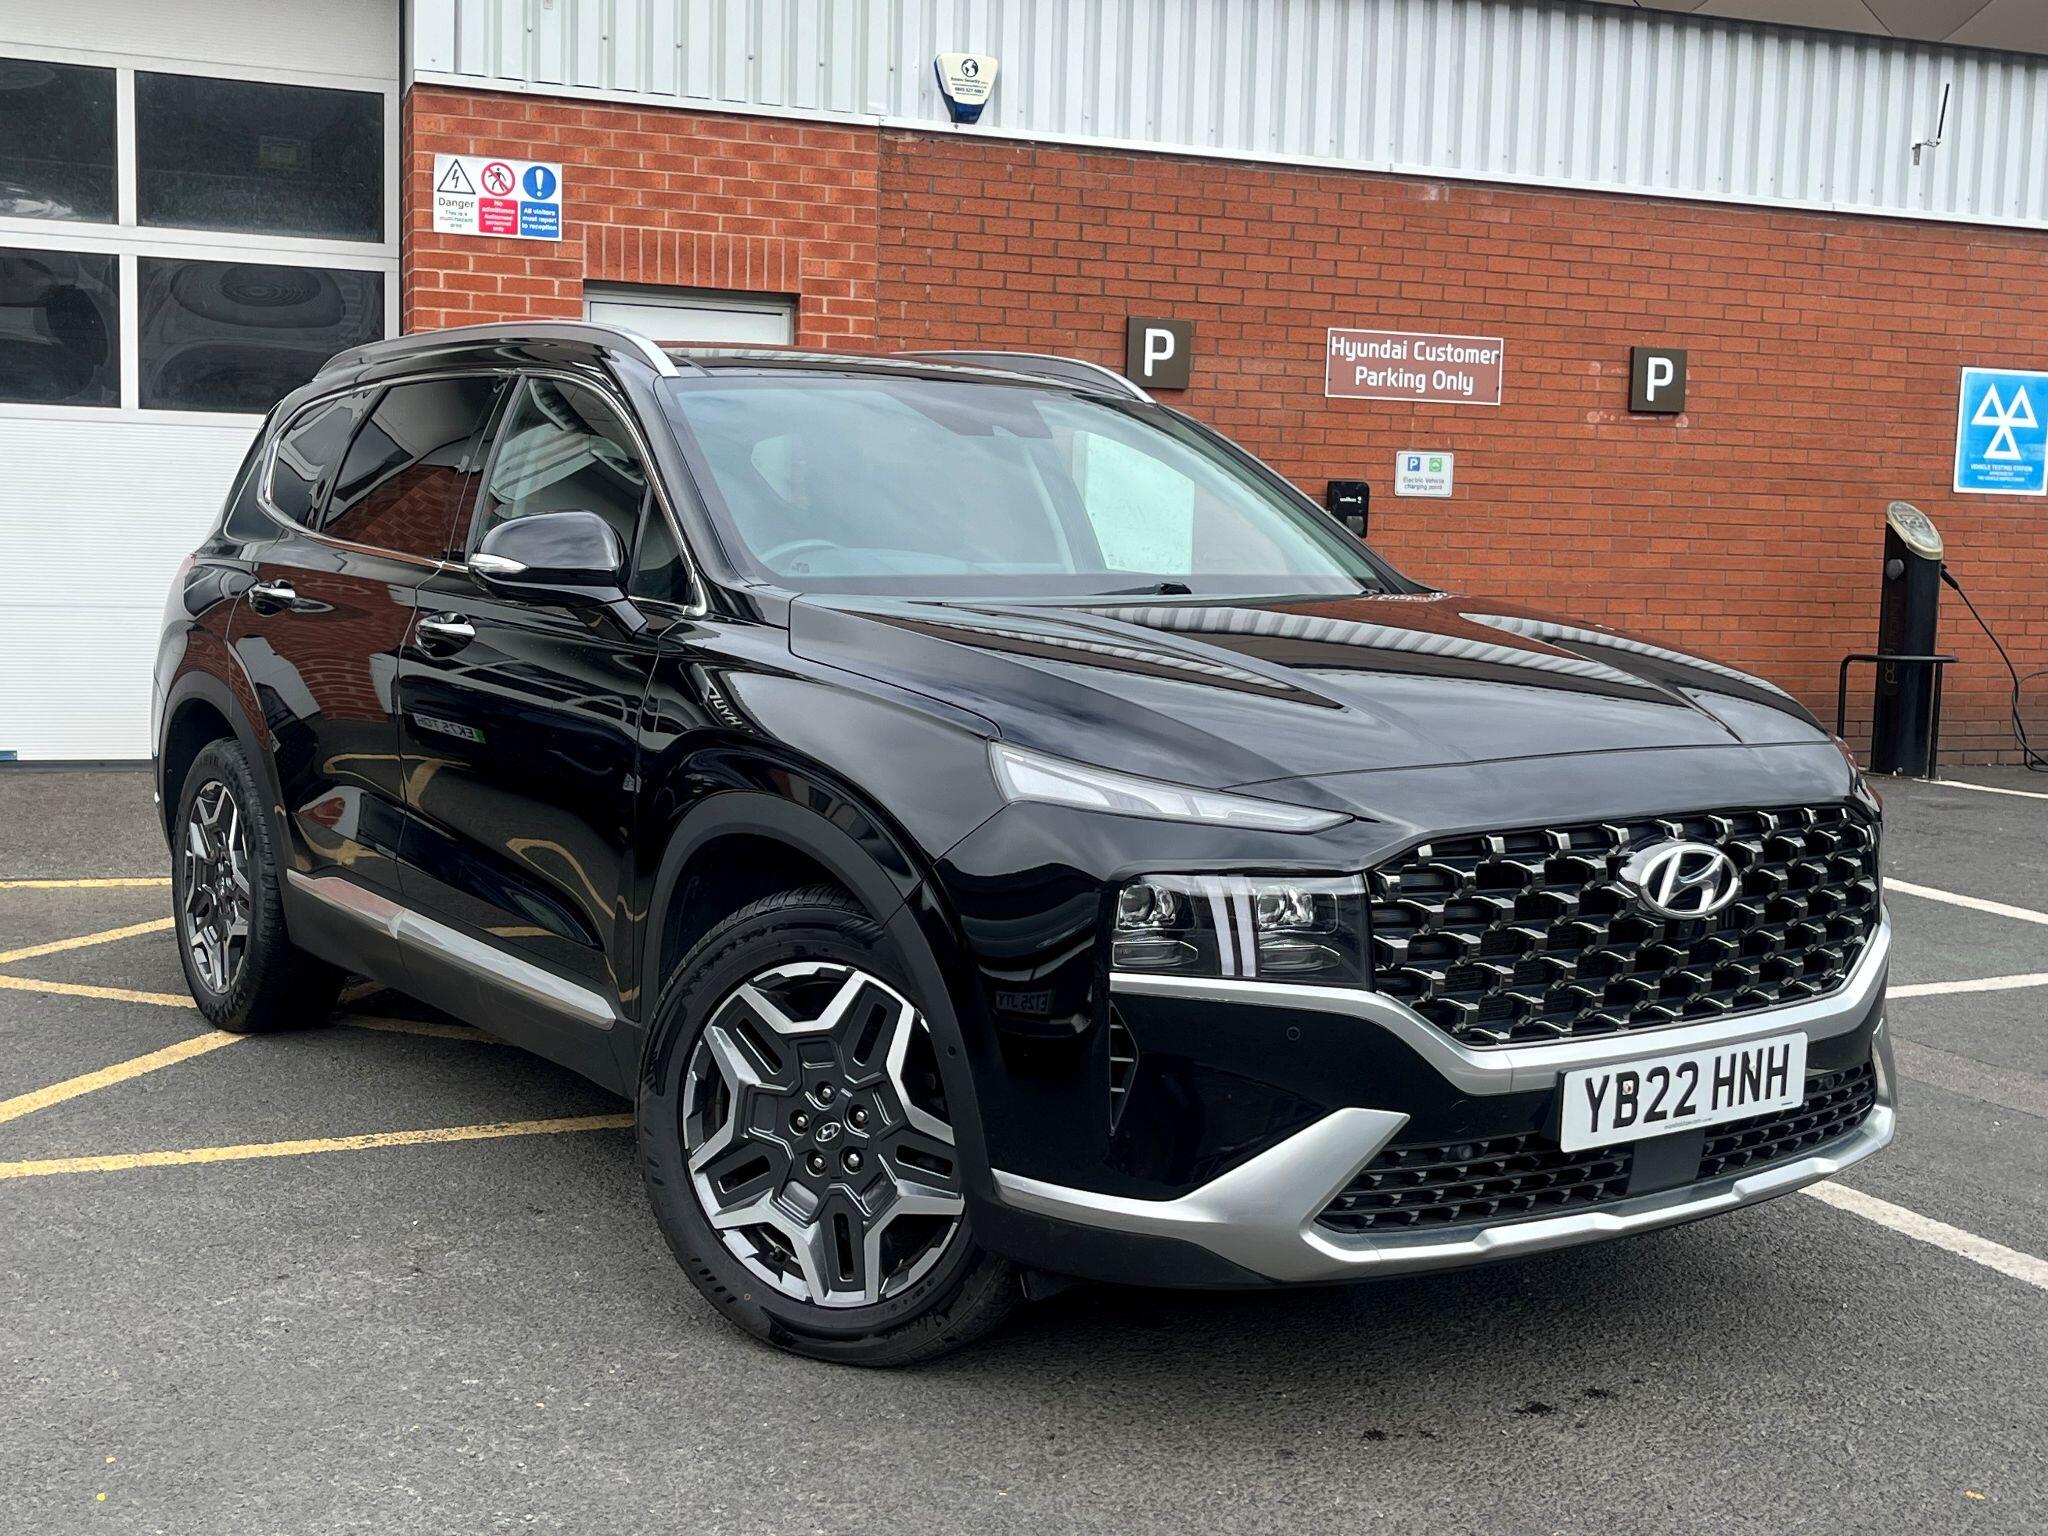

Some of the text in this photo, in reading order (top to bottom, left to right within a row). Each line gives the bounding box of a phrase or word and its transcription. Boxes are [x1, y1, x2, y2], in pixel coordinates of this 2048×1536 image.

[438, 197, 474, 210] Danger
[1143, 328, 1176, 378] P
[1331, 336, 1500, 365] Hyundai Customer
[1355, 366, 1474, 396] Parking Only
[1646, 356, 1674, 402] P
[1410, 458, 1418, 470] P
[1584, 1043, 1791, 1133] YB22 HNH
